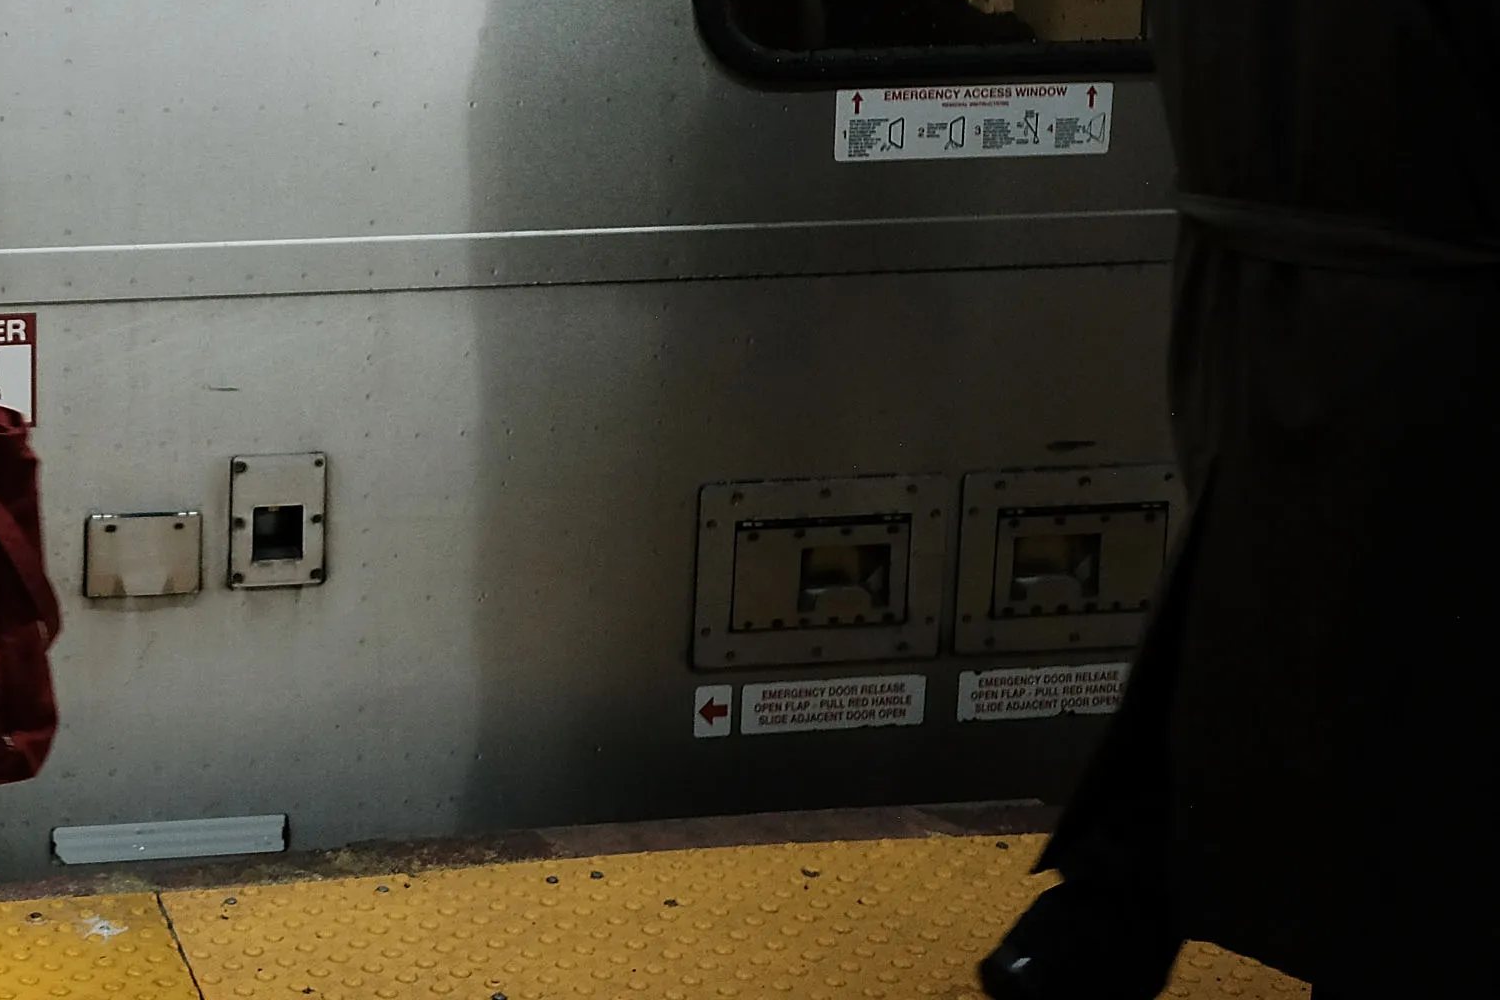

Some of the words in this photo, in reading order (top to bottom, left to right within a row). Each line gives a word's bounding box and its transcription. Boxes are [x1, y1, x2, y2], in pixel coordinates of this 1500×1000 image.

[884, 88, 961, 101] EMERGENCY
[964, 87, 1012, 99] ACCESS
[1015, 86, 1067, 97] WINDOW
[918, 127, 925, 138] 2
[978, 675, 1041, 689] EMERGENCY
[1043, 674, 1073, 685] DOOR
[1075, 671, 1119, 683] RELEASE
[762, 687, 825, 700] EMERGENCY
[828, 686, 858, 696] DOOR
[860, 683, 906, 695] RELEASE
[970, 690, 998, 701] OPEN
[1000, 687, 1026, 699] FLAP
[1035, 686, 1059, 697] PULL
[1062, 684, 1083, 695] RED
[754, 702, 783, 713] OPEN
[784, 700, 810, 711] FLAP
[819, 699, 845, 709] PULL
[848, 697, 869, 707] RED
[871, 695, 912, 706] HANDLE
[974, 702, 1003, 714] SLIDE
[1006, 699, 1058, 712] ADJACENT
[1060, 697, 1090, 708] DOOR
[758, 713, 787, 725] SLIDE
[790, 711, 843, 723] ADJACENT
[846, 710, 875, 721] DOOR
[878, 709, 906, 719] OPEN
